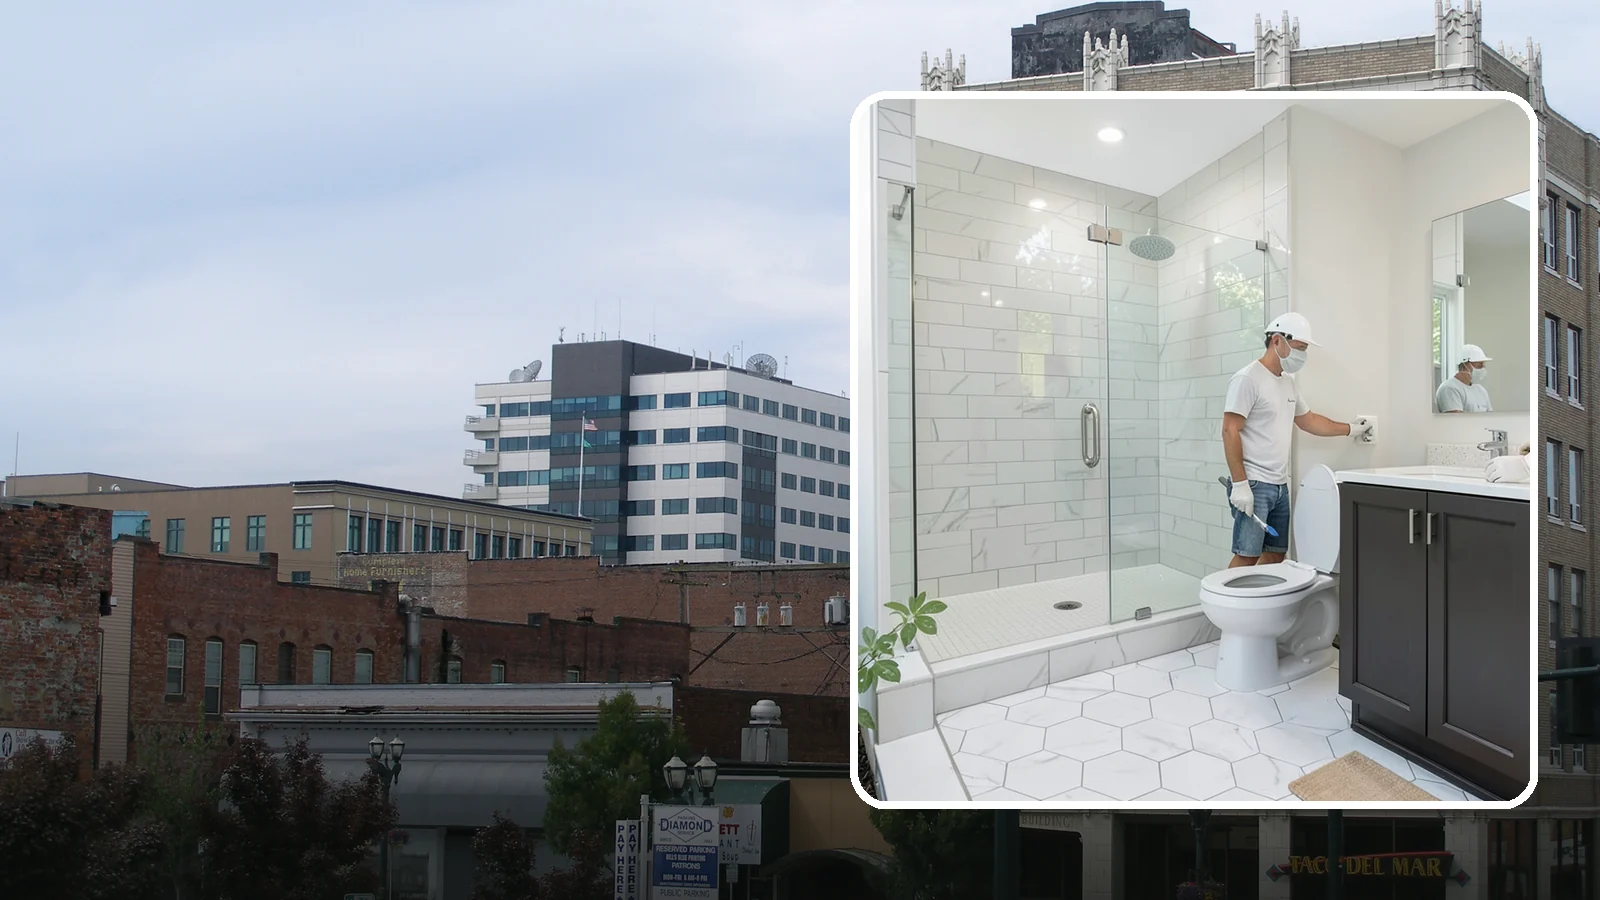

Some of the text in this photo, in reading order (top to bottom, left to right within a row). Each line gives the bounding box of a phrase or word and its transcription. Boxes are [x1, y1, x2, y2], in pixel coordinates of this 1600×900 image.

[343, 566, 427, 577] Home Furnishers
[660, 818, 713, 833] DIAMOND
[1021, 815, 1069, 828] BUILDING
[655, 845, 716, 854] RESERVED PARKING
[616, 824, 625, 894] PAY HERE
[627, 824, 637, 894] PAY HERE
[671, 862, 701, 870] PATRONS
[1346, 856, 1385, 876] DEL
[1392, 857, 1442, 877] MAR
[660, 888, 710, 899] PUBLIC PARKING
